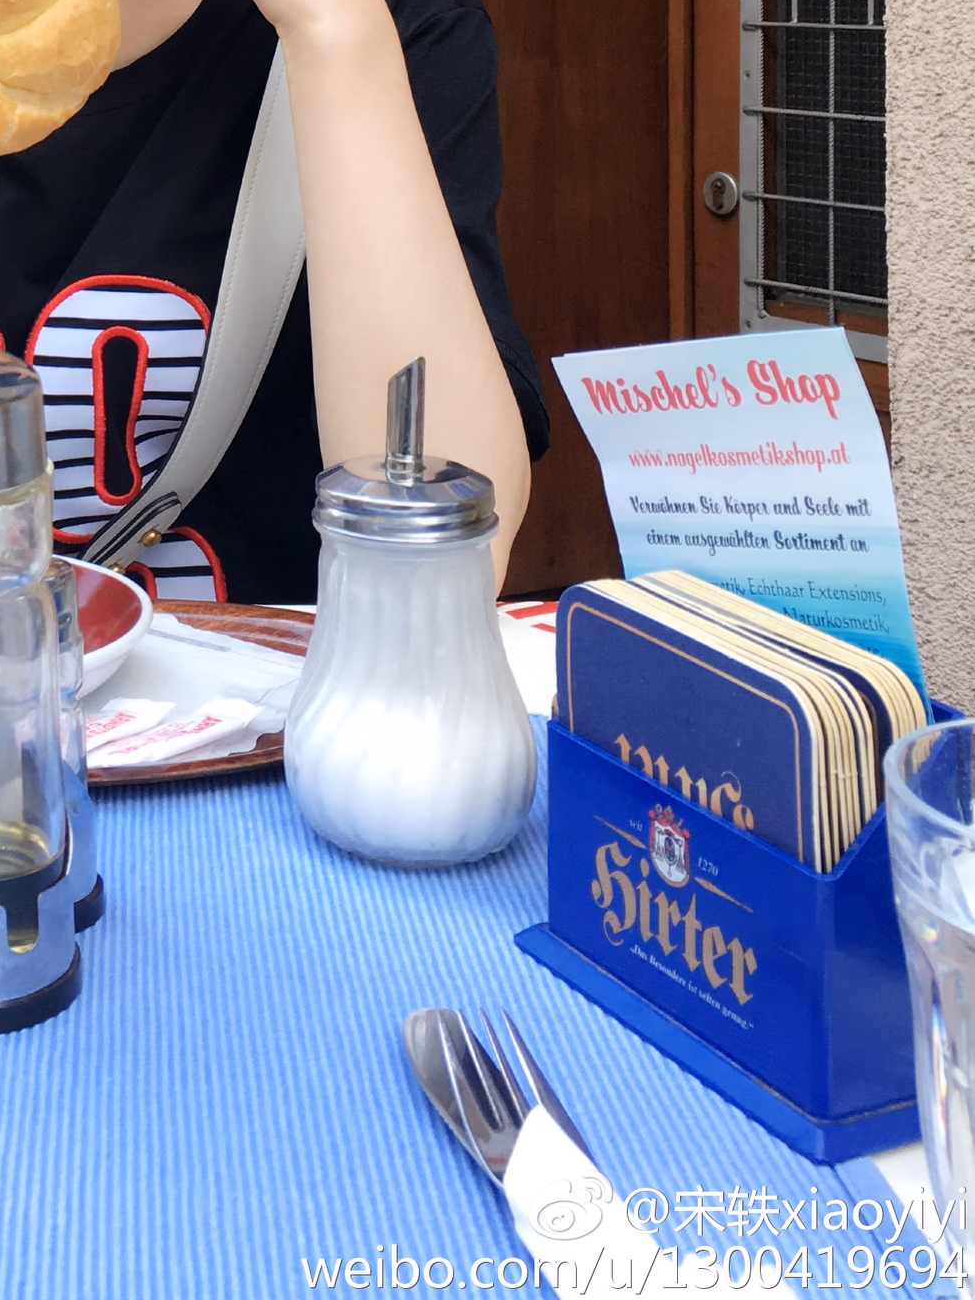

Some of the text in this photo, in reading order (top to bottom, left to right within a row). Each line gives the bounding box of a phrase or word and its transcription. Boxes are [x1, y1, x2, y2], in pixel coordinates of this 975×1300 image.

[581, 359, 841, 420] Mischel's Shop
[628, 441, 852, 475] www.nagelkosmetikshop.at
[629, 496, 872, 522] Verwöhnen Sie Körper und Seele mit
[646, 529, 870, 556] einem ausgewählten Sortiment an
[747, 578, 804, 598] Echthaar
[807, 581, 887, 606] Extensions,
[697, 856, 719, 877] 1270
[591, 841, 759, 1005] Hirter
[649, 955, 686, 987] Besondere
[688, 980, 698, 994] ist
[699, 990, 721, 1009] selten
